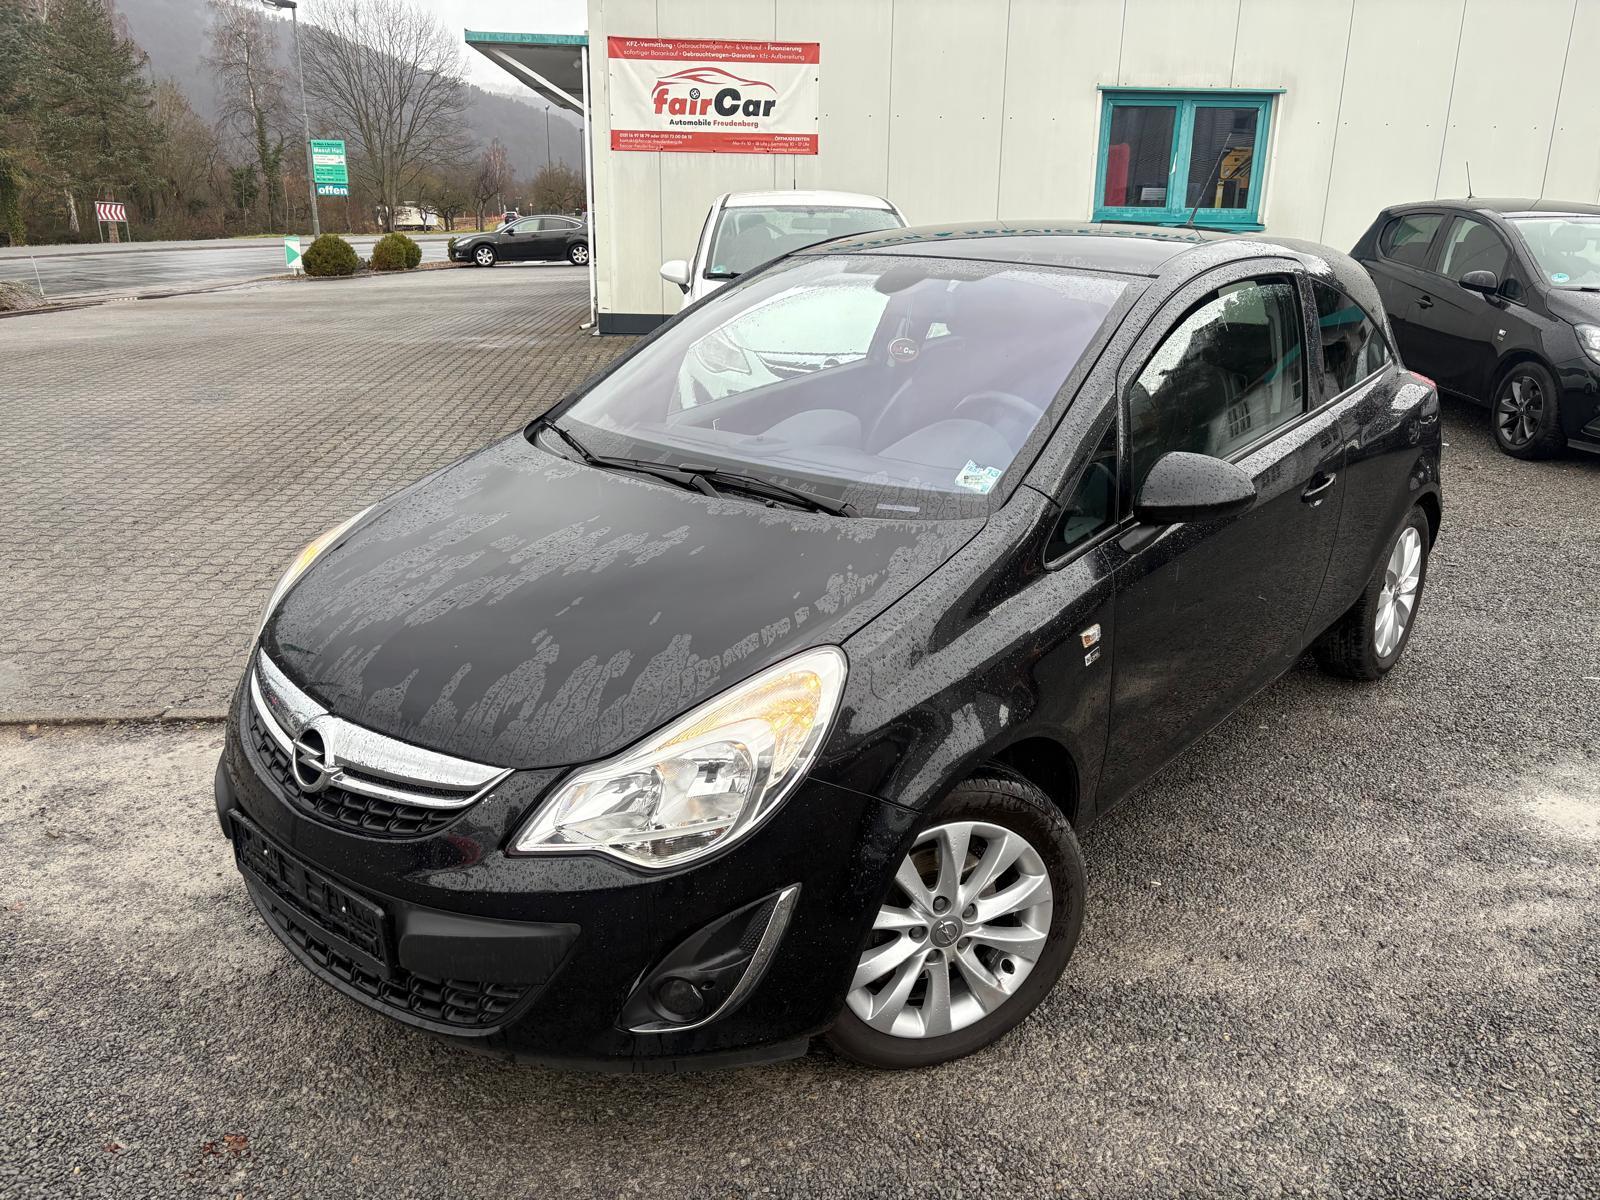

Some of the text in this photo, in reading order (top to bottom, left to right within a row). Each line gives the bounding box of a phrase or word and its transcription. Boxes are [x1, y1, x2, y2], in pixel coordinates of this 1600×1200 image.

[626, 41, 673, 49] KFZ-Vermittlung
[676, 42, 723, 51] Gebrauchtwagen
[767, 43, 802, 53] Finanzierung
[682, 51, 756, 59] Gebrauchtwagen-Garantie
[759, 53, 805, 61] Kfz-Aufbereitung
[653, 87, 777, 117] fairCar
[669, 119, 759, 128] Automobile Freudenberg
[318, 185, 347, 195] offen
